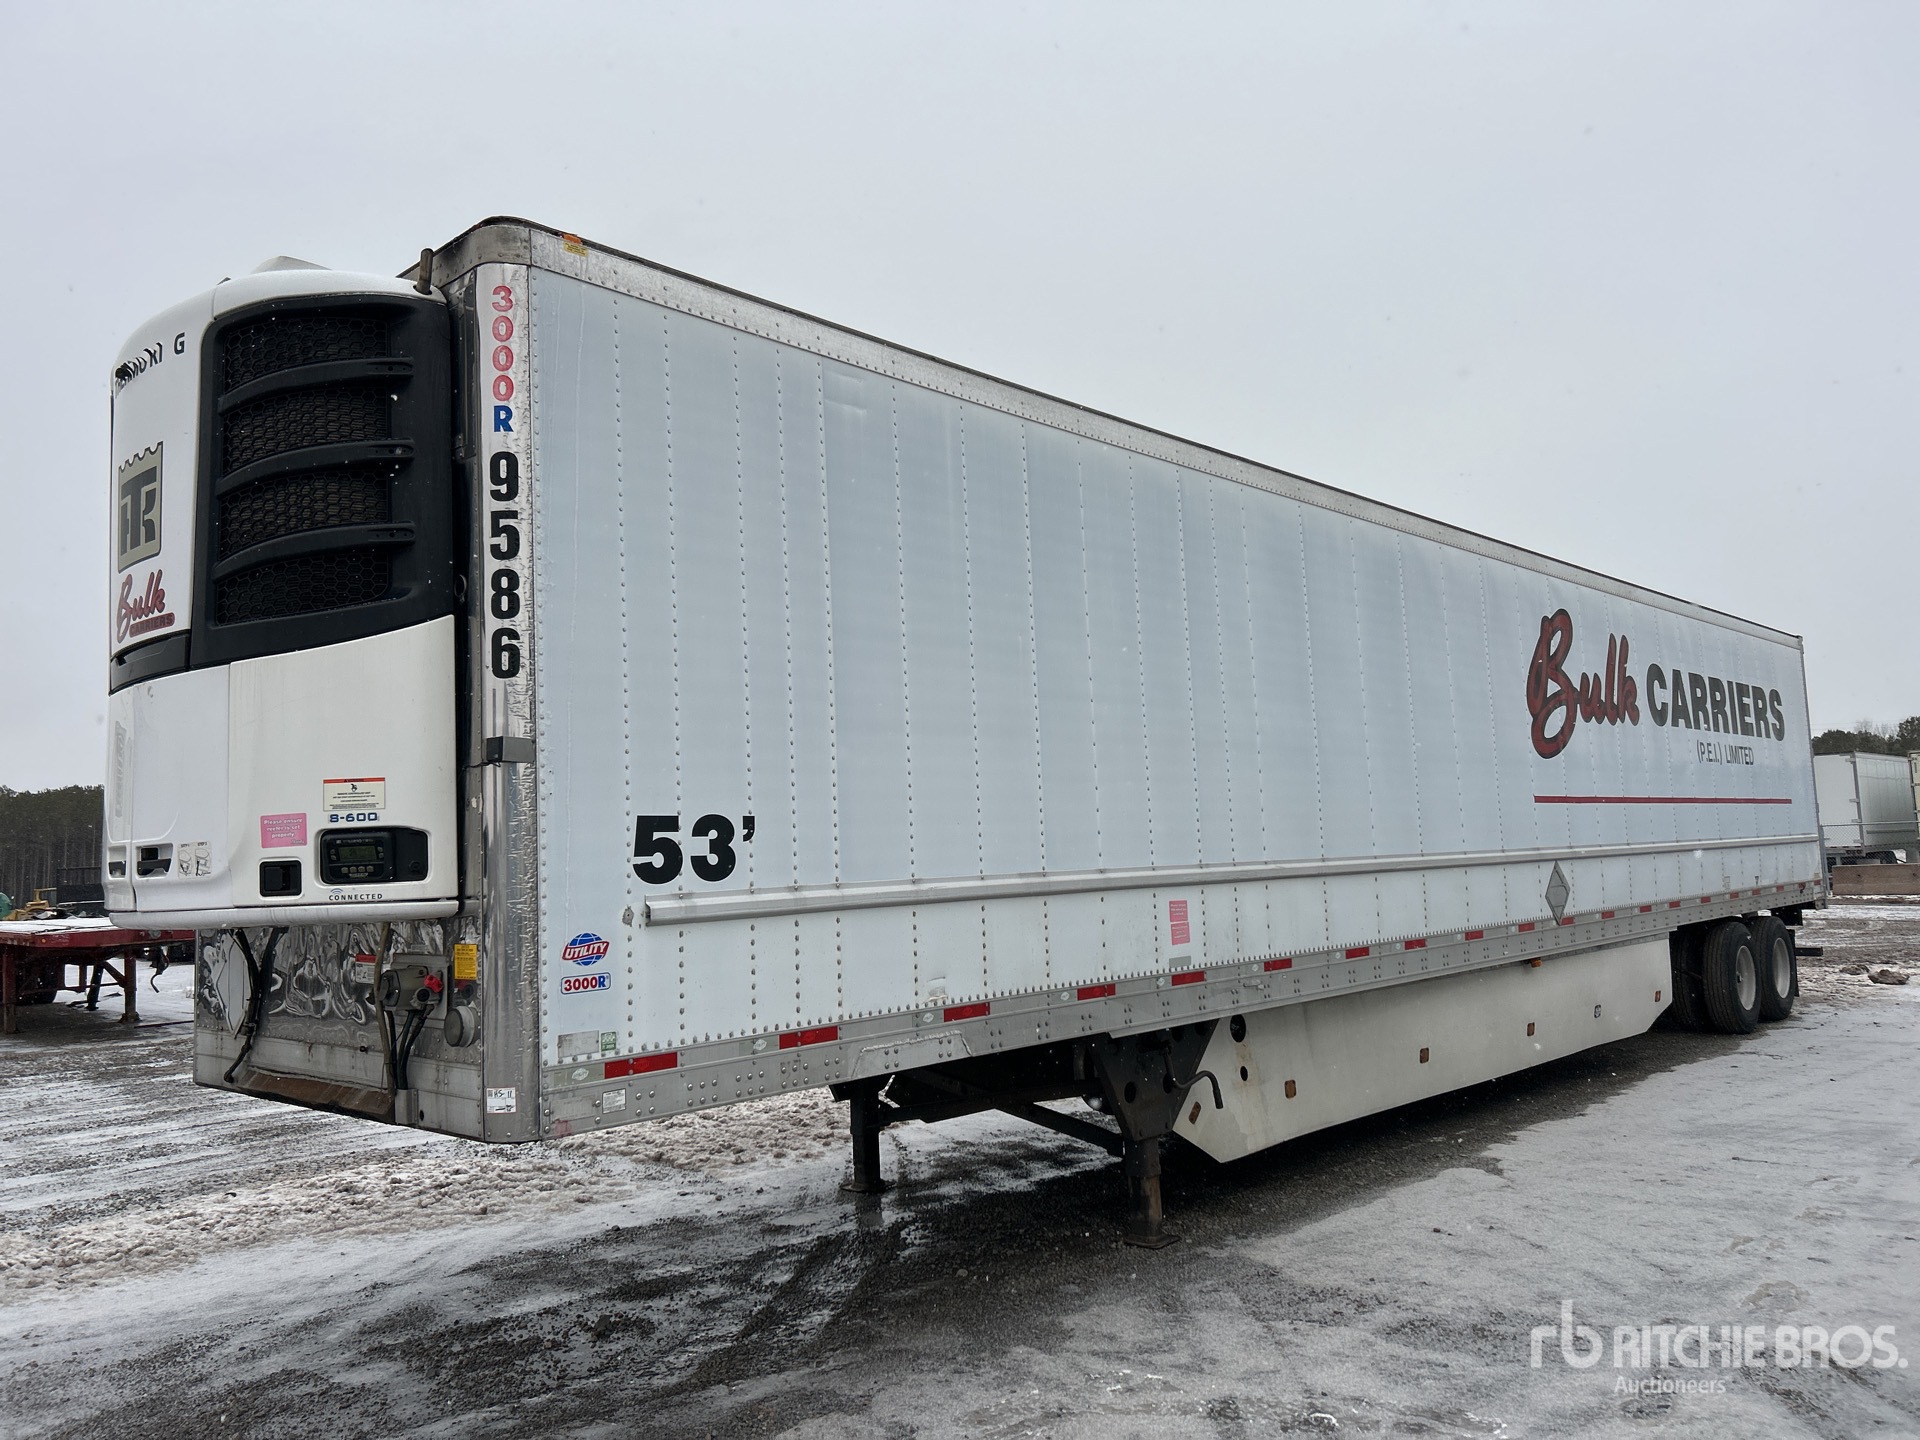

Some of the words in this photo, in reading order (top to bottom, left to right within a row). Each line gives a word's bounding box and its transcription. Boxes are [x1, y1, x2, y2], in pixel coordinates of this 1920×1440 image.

[491, 285, 515, 432] 3000R
[489, 451, 520, 679] 9586
[117, 569, 165, 643] Bulk
[1526, 608, 1640, 759] Bulk
[1646, 663, 1785, 742] CARRIERS
[1724, 744, 1755, 766] LIMITED
[328, 893, 383, 901] CONNECTED
[564, 942, 608, 959] UTILITY
[563, 975, 607, 992] 3000R
